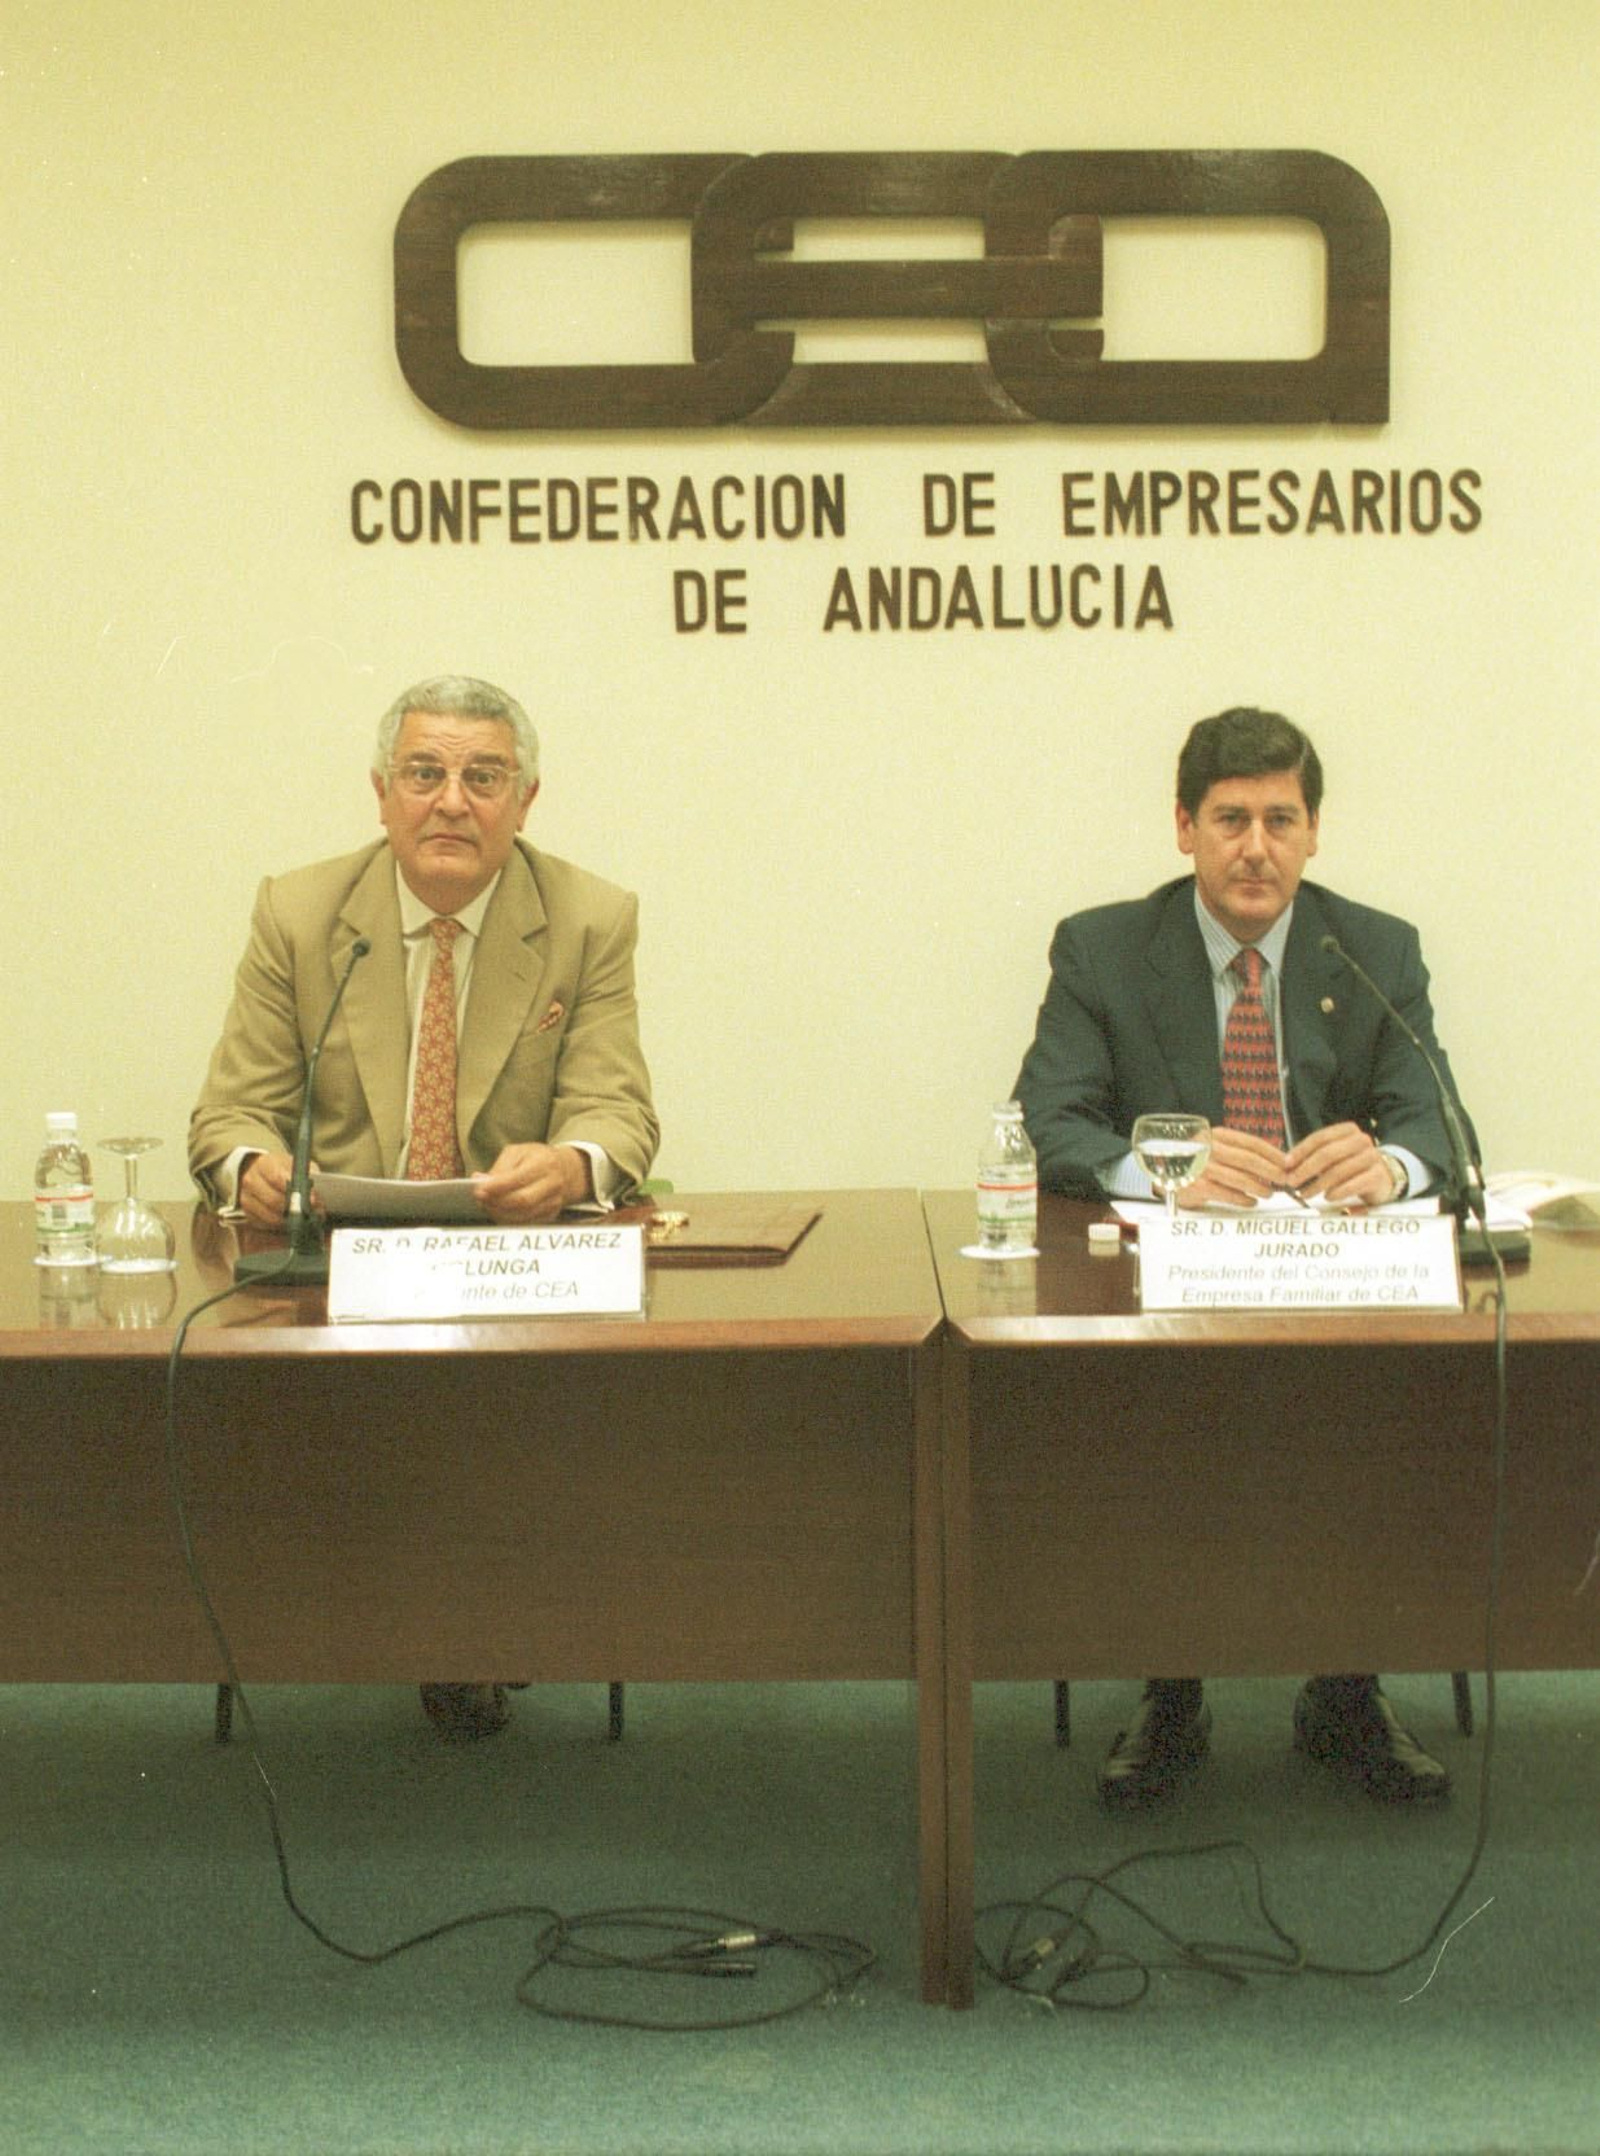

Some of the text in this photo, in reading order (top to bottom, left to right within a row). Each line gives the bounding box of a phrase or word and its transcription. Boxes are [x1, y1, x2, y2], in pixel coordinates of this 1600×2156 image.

[350, 468, 1483, 545] CONFEDERACION DE EMPRESARIOS
[673, 564, 1174, 634] DE ANDALUCIA
[1170, 1219, 1203, 1237] SR.
[1235, 1219, 1312, 1237] MIGUEL
[1320, 1218, 1421, 1236] GALLEGO
[518, 1231, 622, 1252] ALVAREZ
[1254, 1242, 1341, 1259] JURADO
[431, 1258, 541, 1276] LUNGA
[1168, 1262, 1431, 1284] Presidente del Consejo de la
[503, 1282, 528, 1299] de
[535, 1280, 580, 1299] CEA
[1181, 1284, 1420, 1306] Empresa Familiar de CEA
